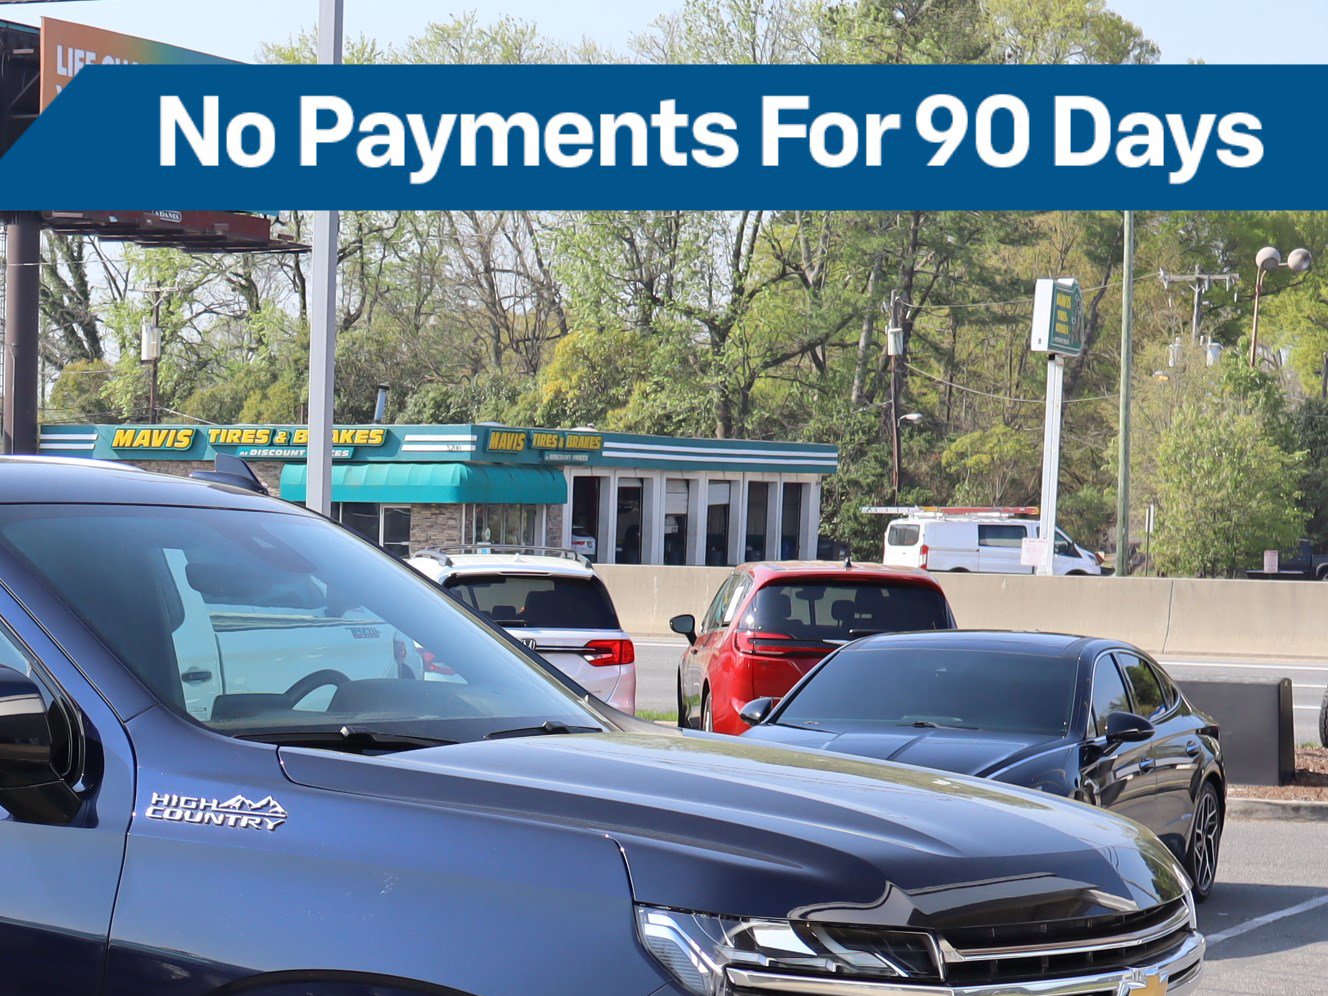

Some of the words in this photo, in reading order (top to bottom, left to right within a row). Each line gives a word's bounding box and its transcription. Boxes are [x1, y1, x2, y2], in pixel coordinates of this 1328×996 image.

[154, 210, 180, 220] ADAMS
[112, 429, 193, 448] MAVIS
[208, 429, 270, 445] TIRES
[273, 430, 288, 444] &
[292, 429, 384, 445] BAKES
[488, 431, 527, 451] MAVIS
[532, 433, 560, 449] TIRES
[566, 435, 603, 450] BRAKES
[150, 791, 222, 812] HIGH
[145, 806, 288, 832] COUNTRY
